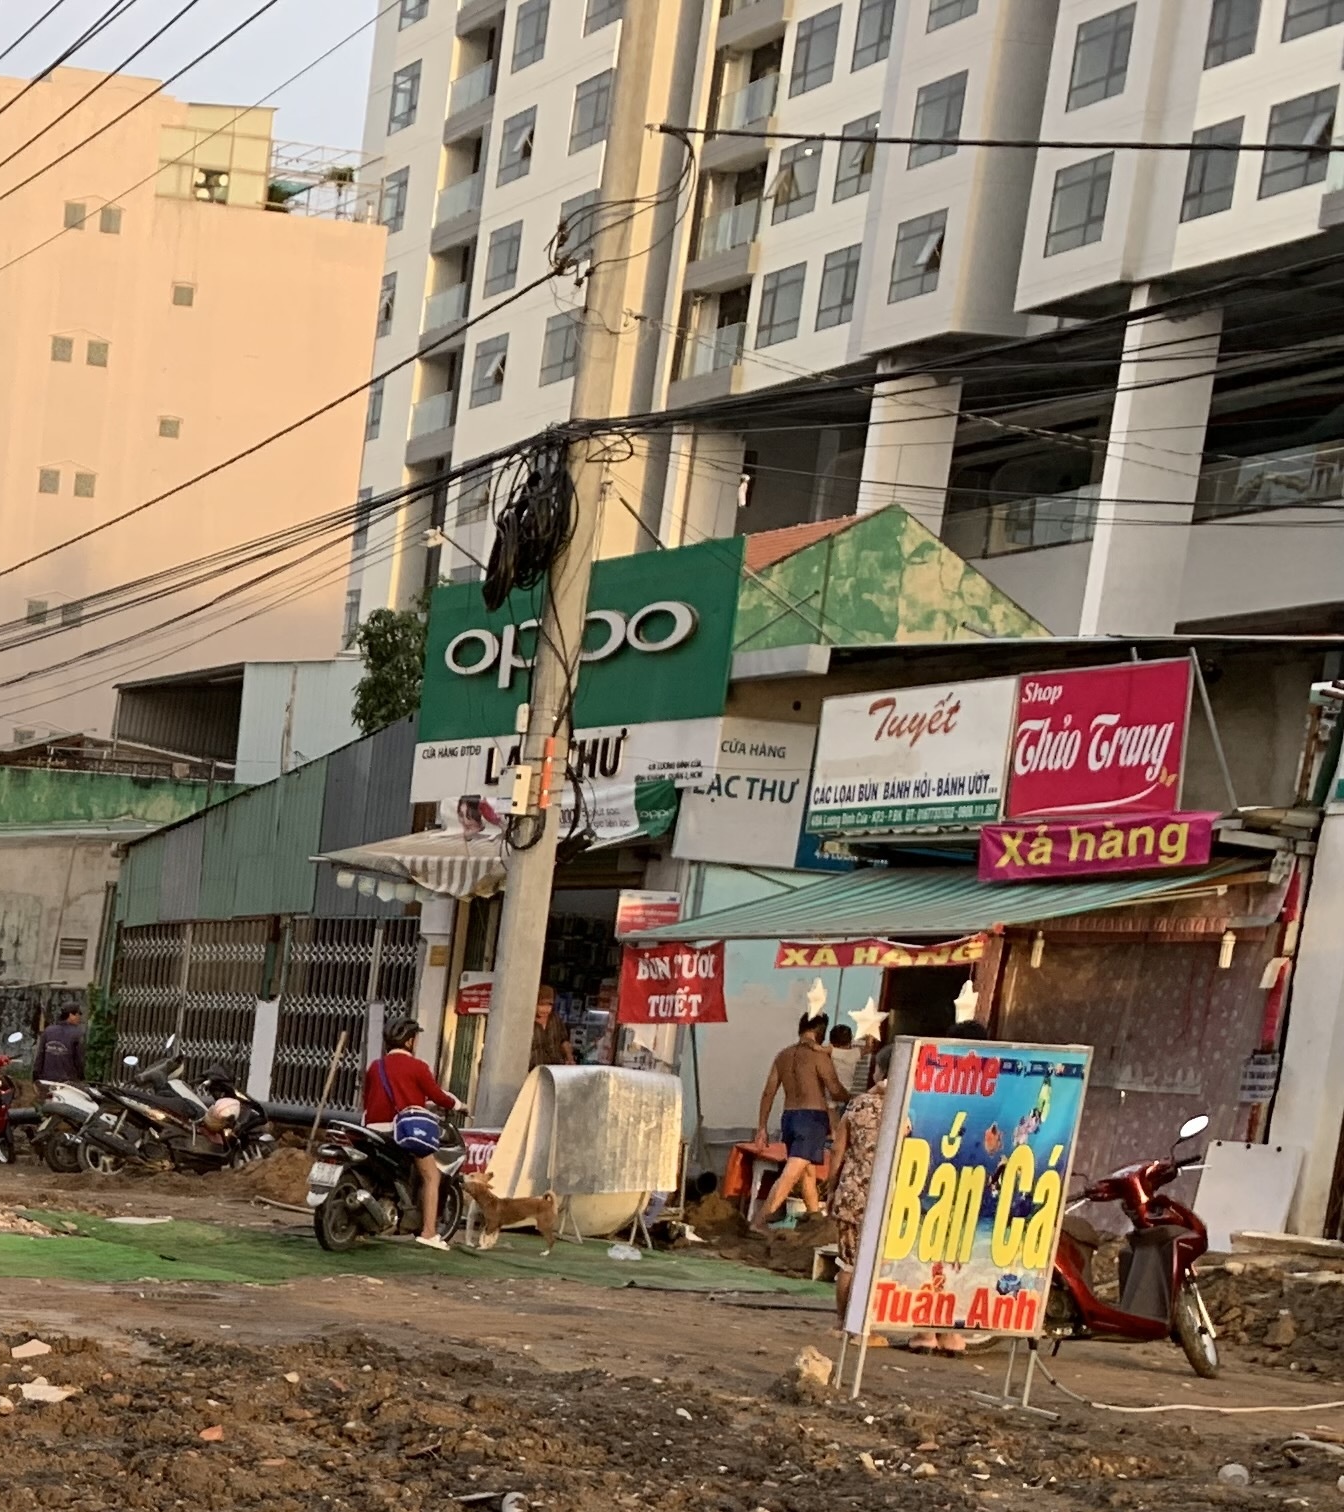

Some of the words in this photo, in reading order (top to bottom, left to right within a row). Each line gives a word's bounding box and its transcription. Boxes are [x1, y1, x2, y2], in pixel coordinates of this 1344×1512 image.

[1021, 682, 1063, 705] Shop
[868, 692, 961, 747] Tuyết
[720, 738, 746, 755] CỬA
[749, 741, 787, 759] HÀNG
[1014, 714, 1082, 776] Thảo
[1087, 713, 1175, 782] Trang
[746, 776, 800, 804] THƯ
[882, 777, 911, 800] BÁNH
[995, 825, 1053, 868] Xả
[1068, 821, 1190, 865] hàng
[914, 1043, 1001, 1097] Game
[883, 1111, 987, 1264] Bắn
[990, 1144, 1065, 1270] Cá
[966, 1287, 1041, 1332] Anh
